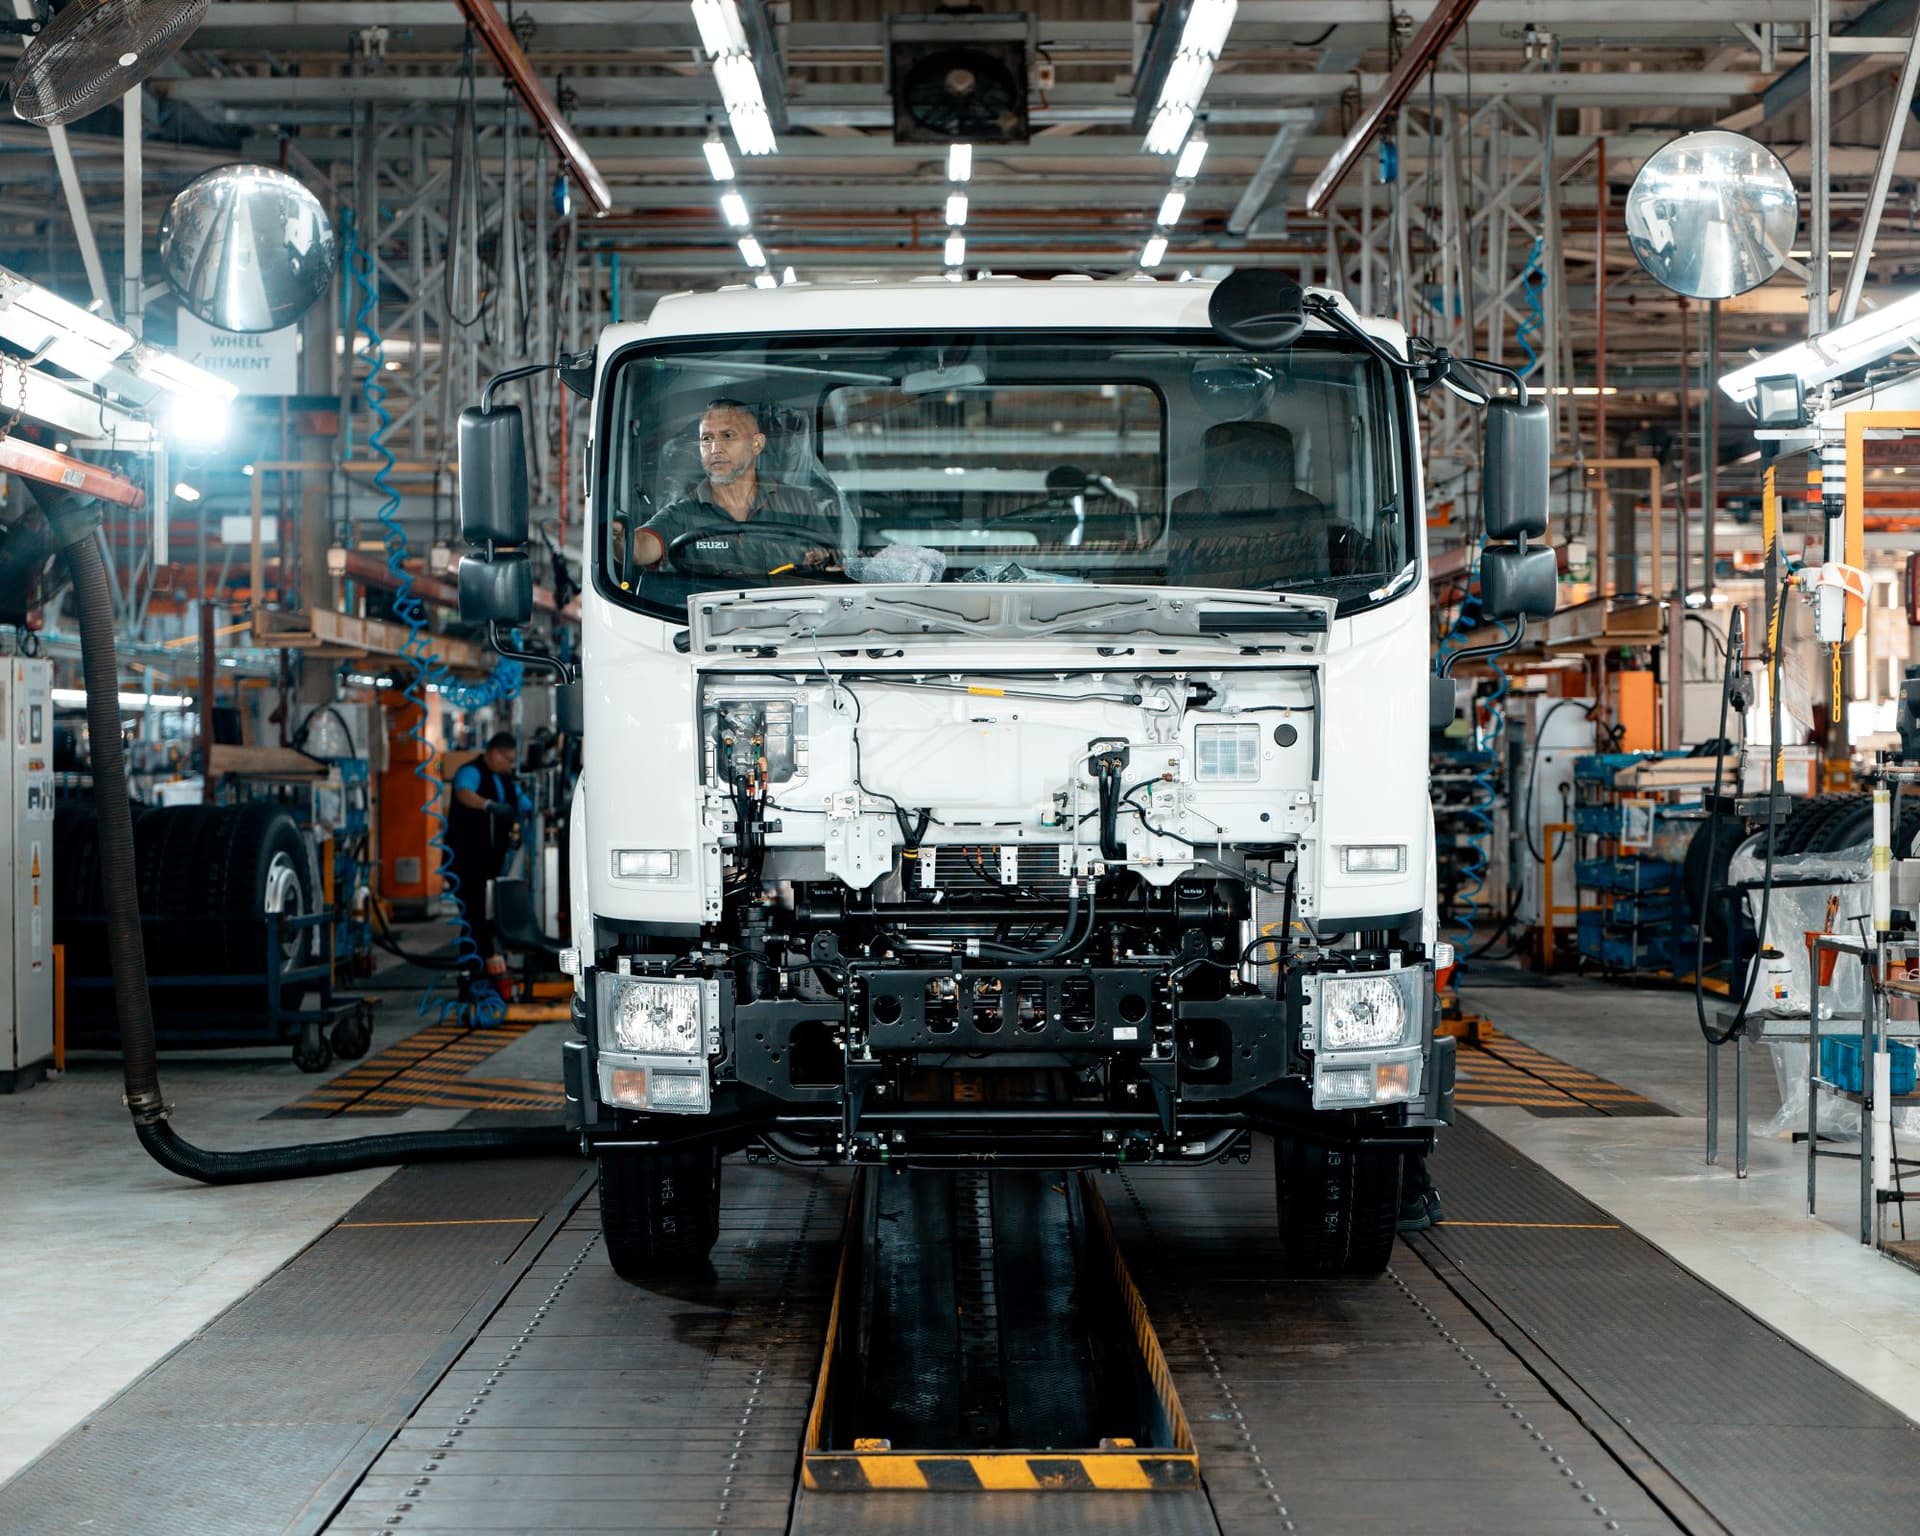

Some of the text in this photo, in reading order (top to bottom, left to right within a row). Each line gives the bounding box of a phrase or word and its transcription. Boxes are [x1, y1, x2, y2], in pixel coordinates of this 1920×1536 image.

[211, 335, 264, 348] WHEEL
[204, 356, 271, 369] FITMENT
[696, 541, 729, 549] ISUZU
